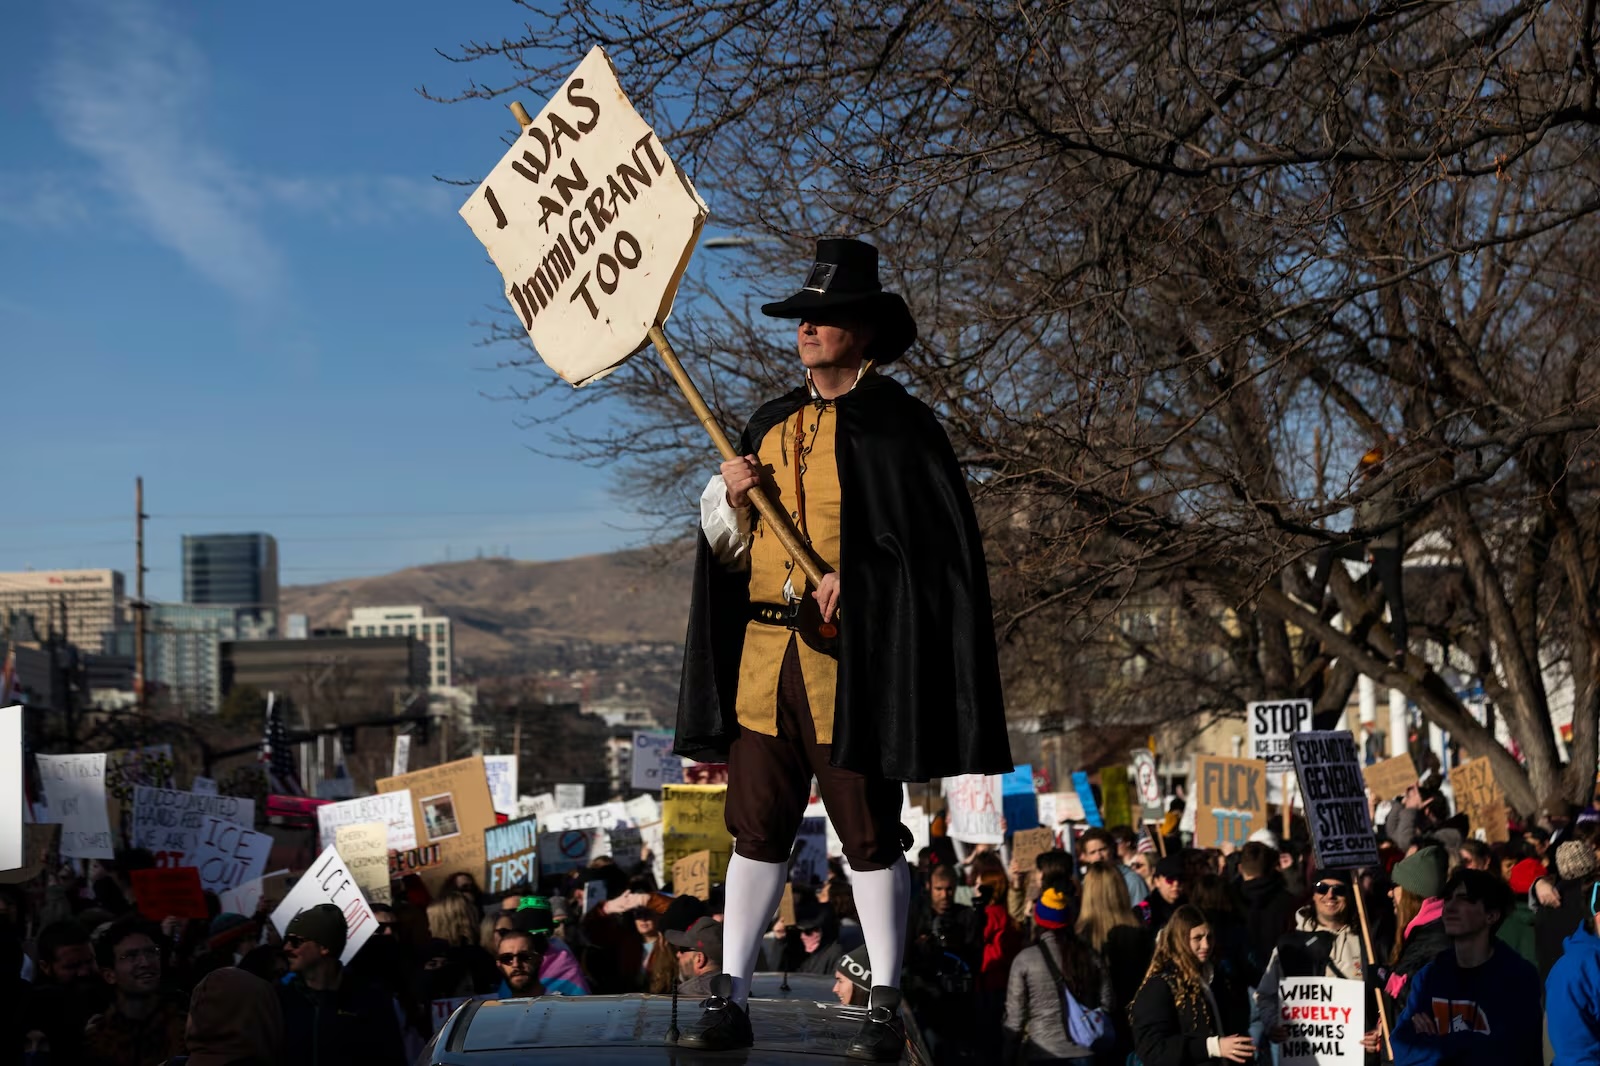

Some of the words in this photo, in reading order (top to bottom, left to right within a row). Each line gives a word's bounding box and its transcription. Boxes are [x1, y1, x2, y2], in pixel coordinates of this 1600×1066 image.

[484, 185, 509, 230] I
[511, 77, 601, 184] WAS
[537, 157, 589, 234] AN
[569, 230, 643, 320] TOO
[1255, 703, 1308, 735] STOP
[1255, 739, 1270, 753] ICE
[1296, 737, 1340, 765] EXPAND
[1338, 737, 1358, 763] THE
[1203, 761, 1261, 812] FUCK
[1303, 763, 1365, 801] GENERAL
[136, 788, 240, 817] UNDOCUMENTED
[562, 808, 611, 831] STOP
[1211, 807, 1253, 847] ICE
[205, 818, 257, 862] ICE
[485, 817, 538, 862] HUMANITY
[1319, 838, 1344, 852] ICE
[1346, 836, 1375, 850] OUT!
[407, 843, 442, 868] OUT
[202, 856, 251, 886] OUT
[490, 852, 537, 894] FIRST
[673, 860, 708, 883] FUCK
[1279, 984, 1333, 1002] WHEN
[1281, 1006, 1352, 1024] CRUELTY
[1282, 1023, 1345, 1040] BECOMES
[1282, 1041, 1345, 1058] NORMAL
